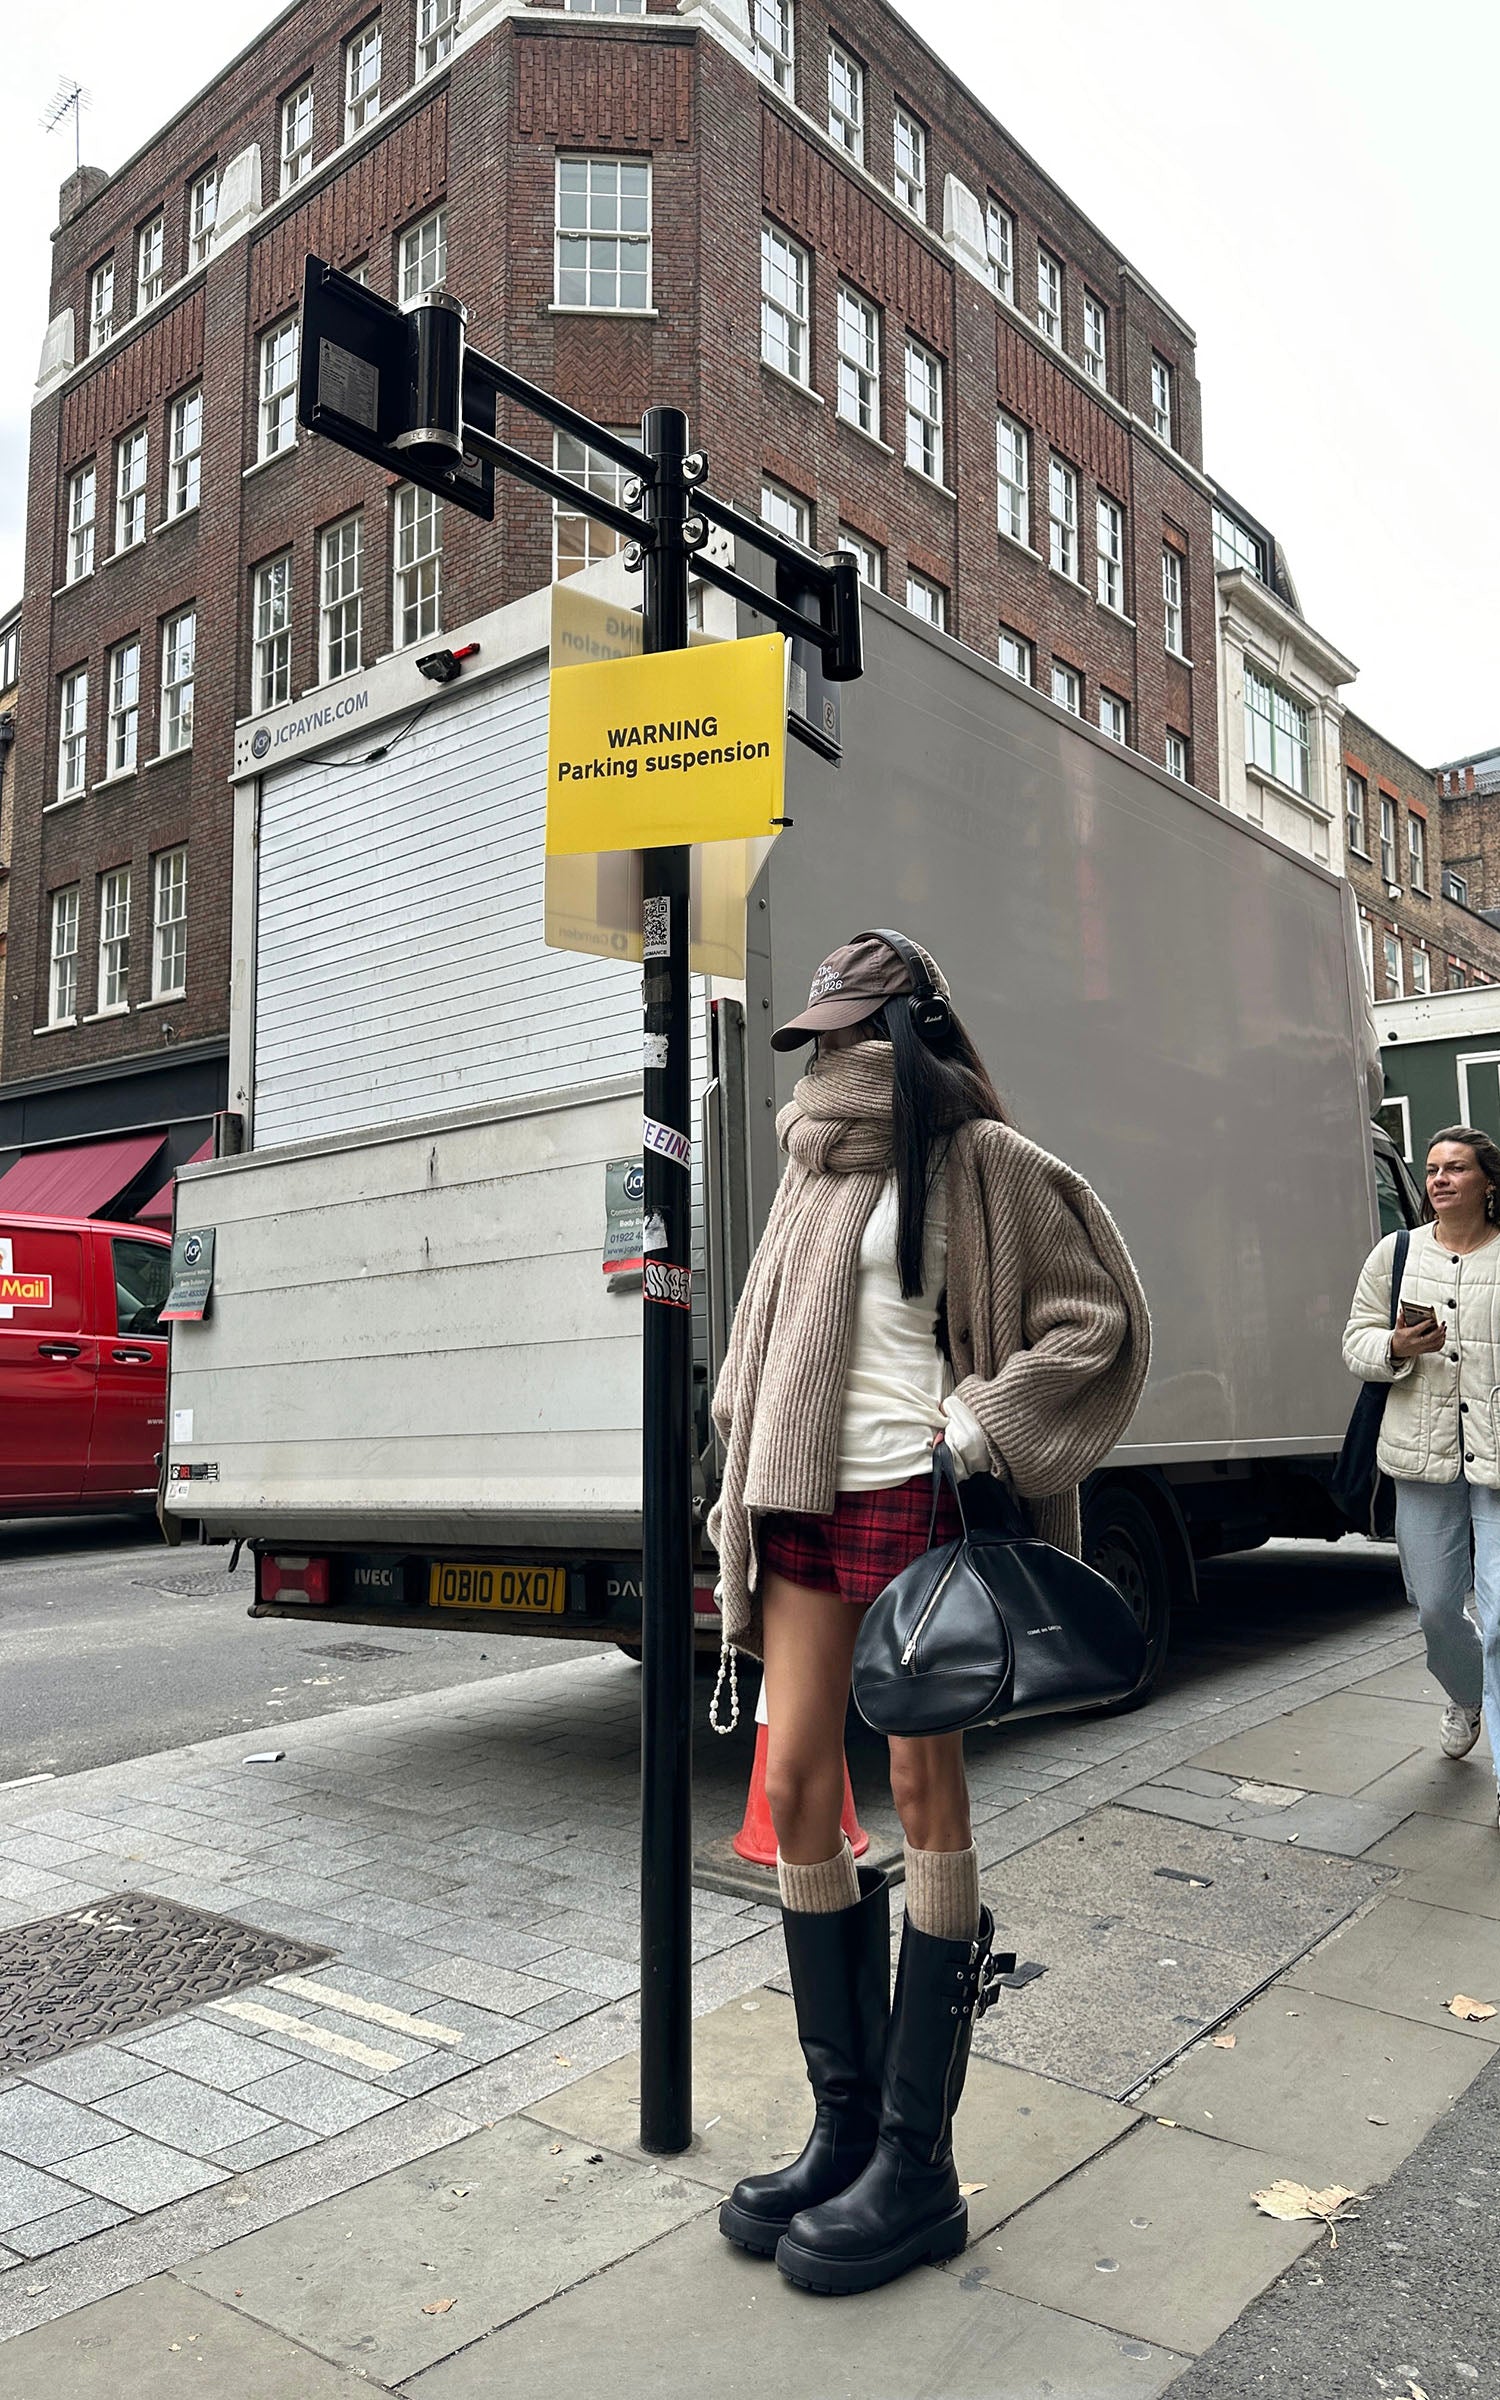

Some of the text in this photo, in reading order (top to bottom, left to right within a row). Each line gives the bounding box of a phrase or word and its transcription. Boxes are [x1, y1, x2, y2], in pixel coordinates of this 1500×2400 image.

[273, 690, 369, 747] JCPAYNE.COM
[607, 716, 718, 749] WARNING
[558, 741, 770, 782] Parking suspension
[610, 1232, 634, 1243] 01922
[187, 1245, 200, 1257] JCP
[1, 1279, 44, 1298] Mail
